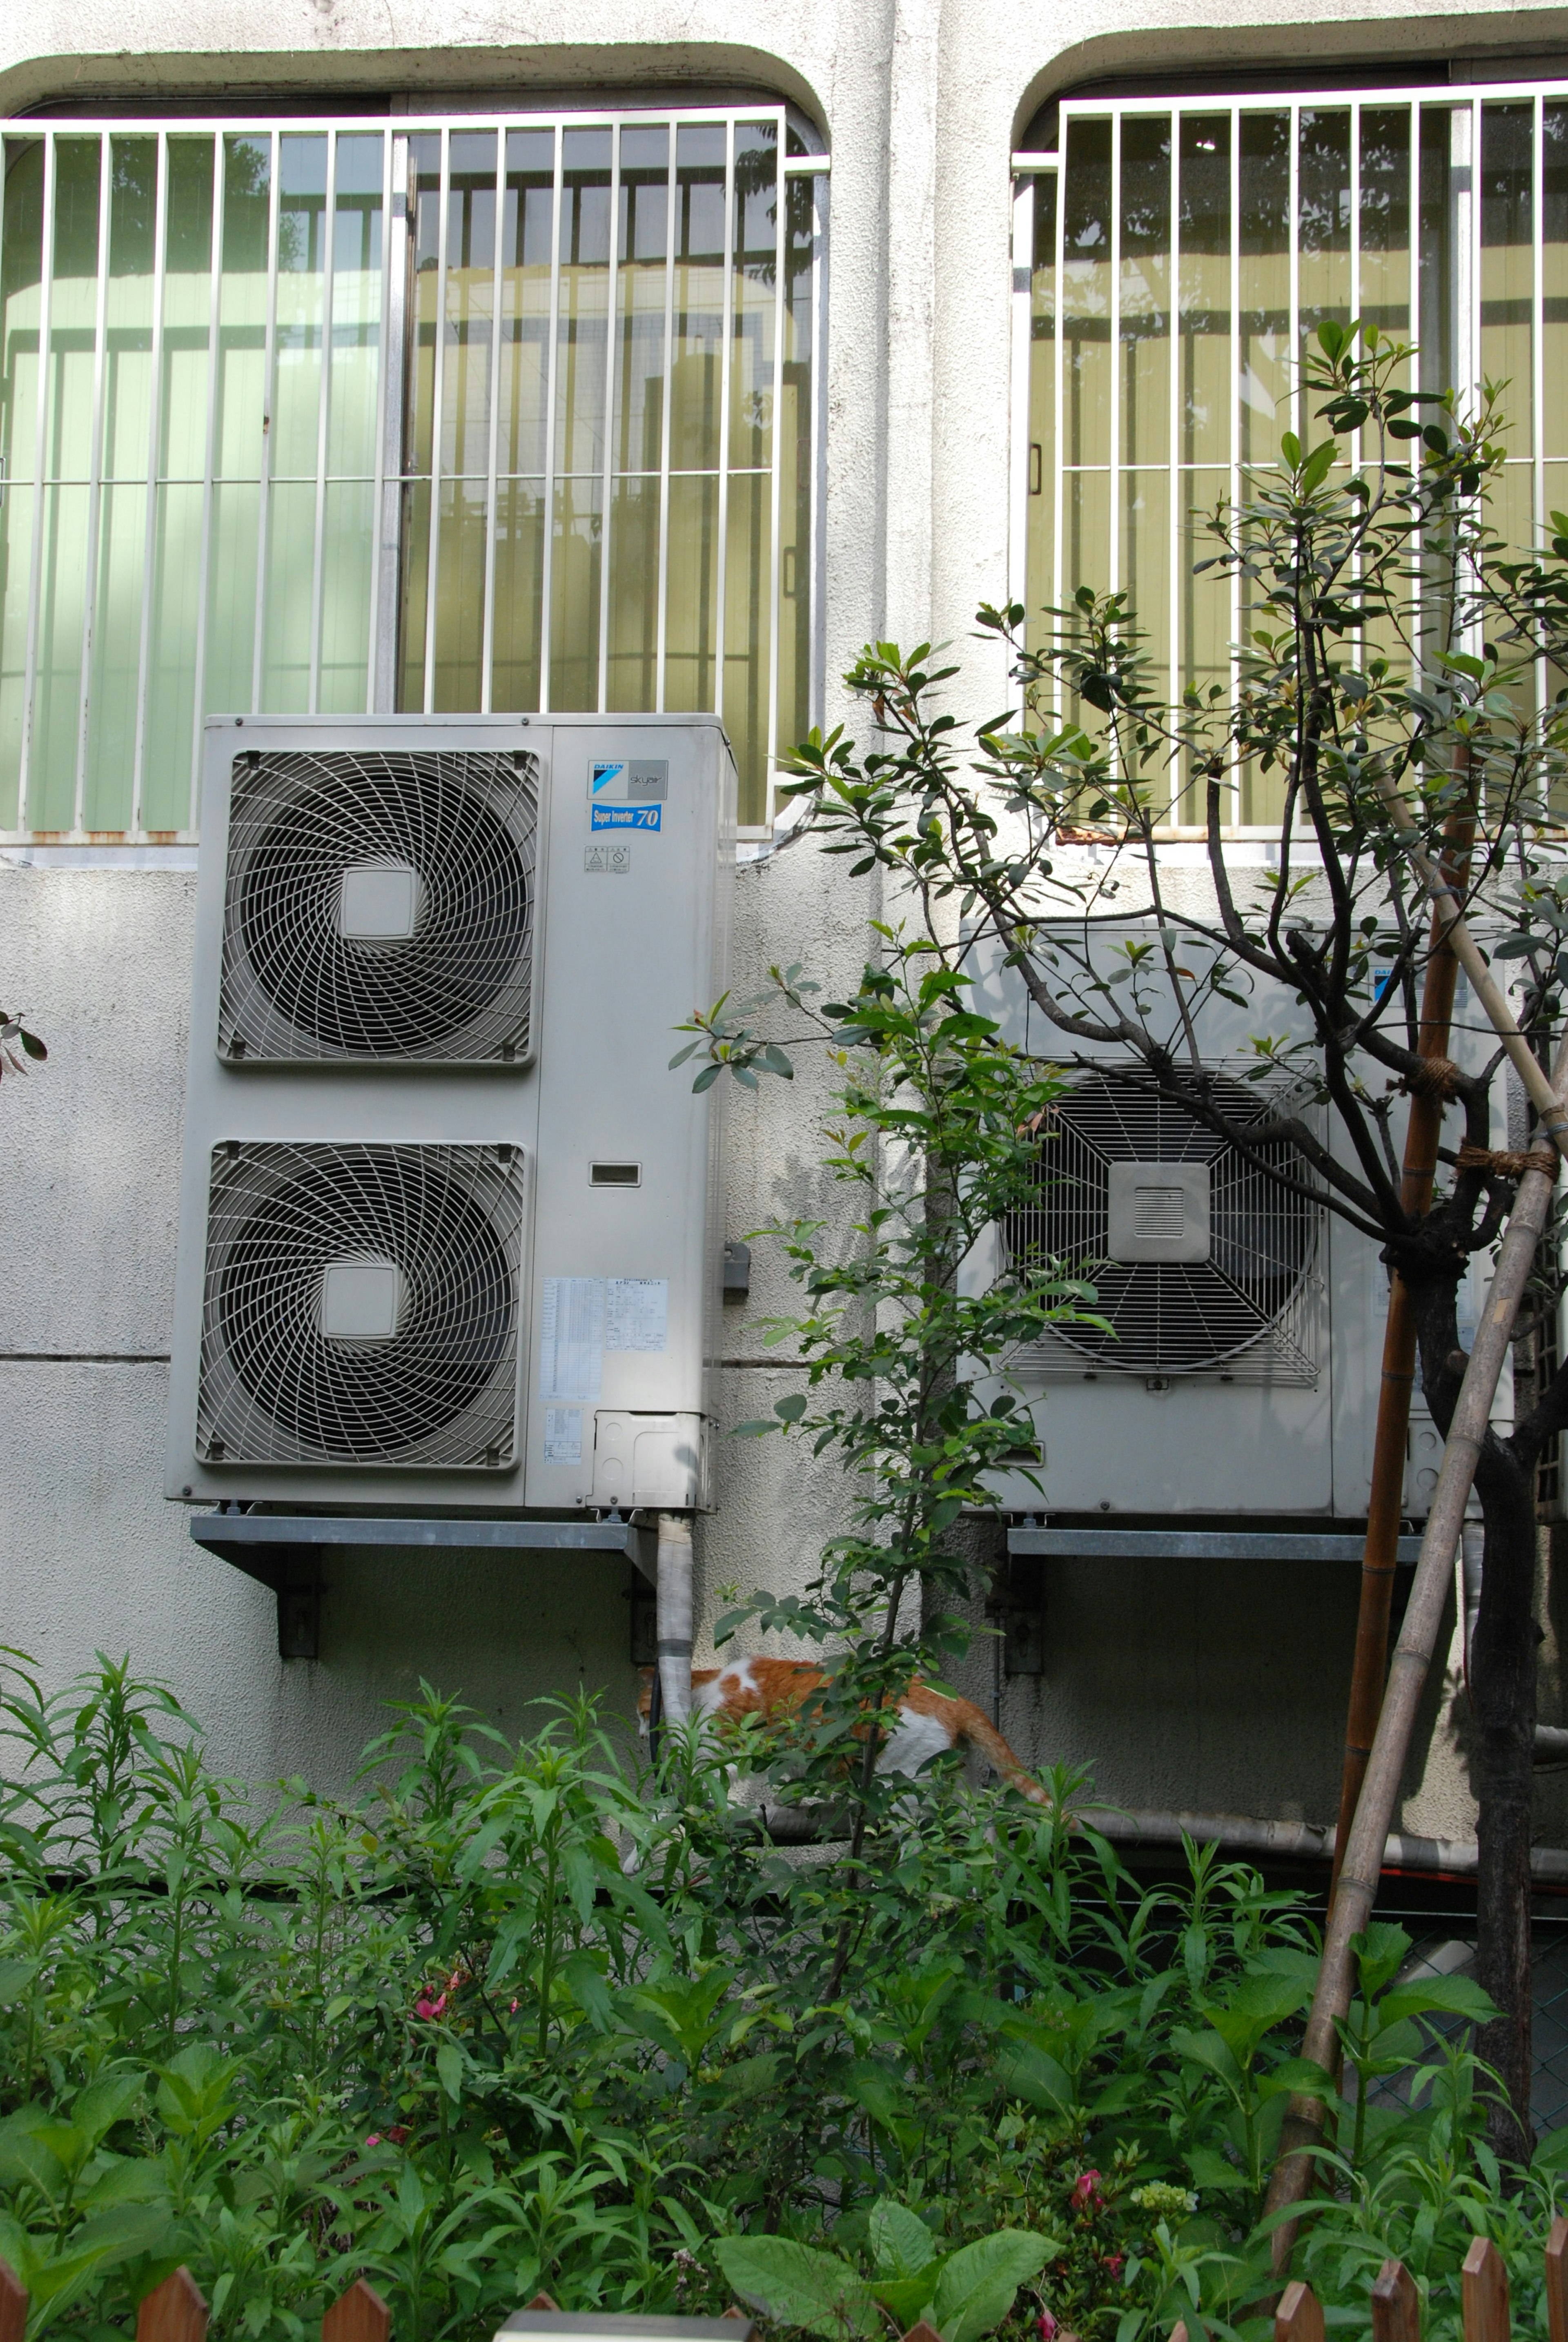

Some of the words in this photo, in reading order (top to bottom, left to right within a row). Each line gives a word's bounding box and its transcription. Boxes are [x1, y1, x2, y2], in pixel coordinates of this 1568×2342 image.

[630, 775, 662, 786] skyair
[594, 810, 611, 826] Super
[612, 811, 634, 823] Inverter
[637, 810, 659, 826] 70
